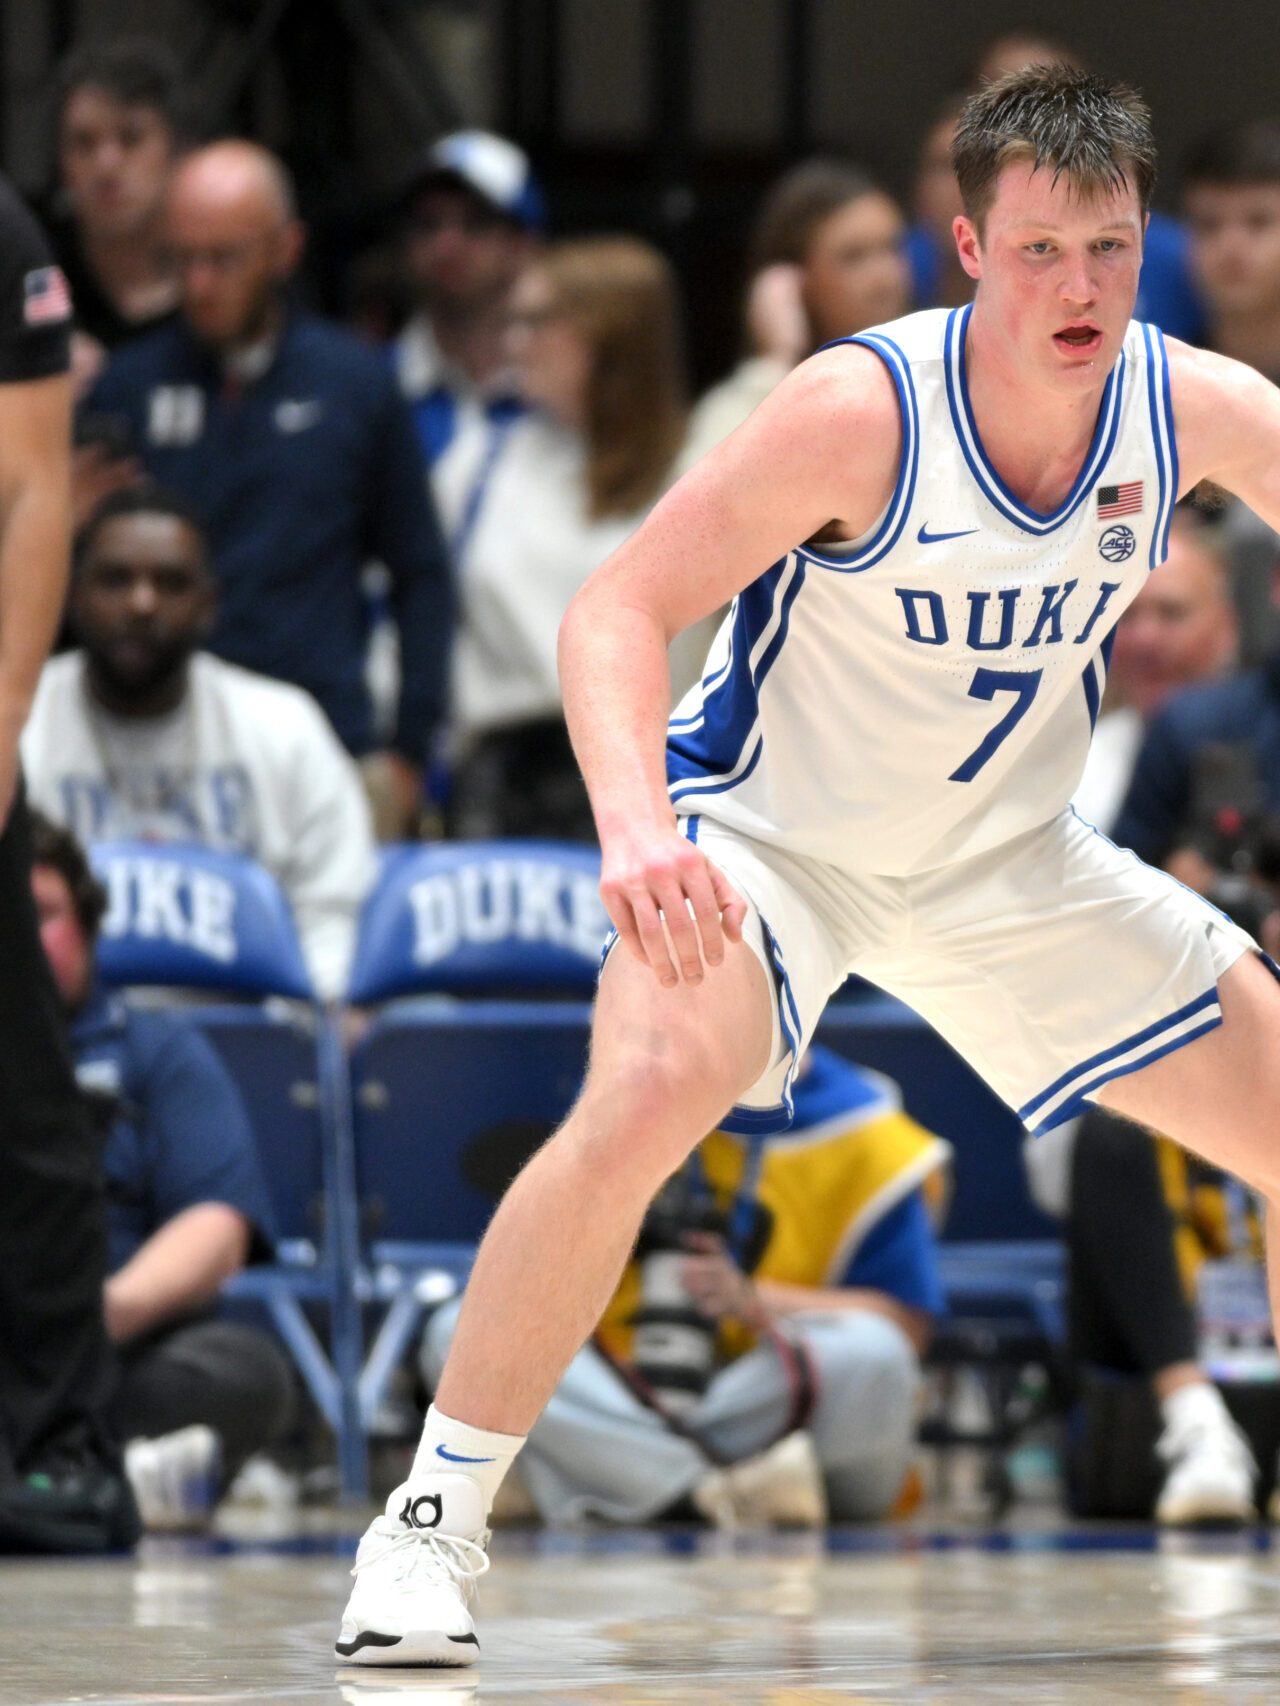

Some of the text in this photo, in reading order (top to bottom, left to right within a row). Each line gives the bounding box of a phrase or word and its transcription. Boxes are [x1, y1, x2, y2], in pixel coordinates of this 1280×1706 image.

[1101, 536, 1134, 550] ACC
[947, 667, 1044, 783] 7
[102, 857, 237, 963] UKE
